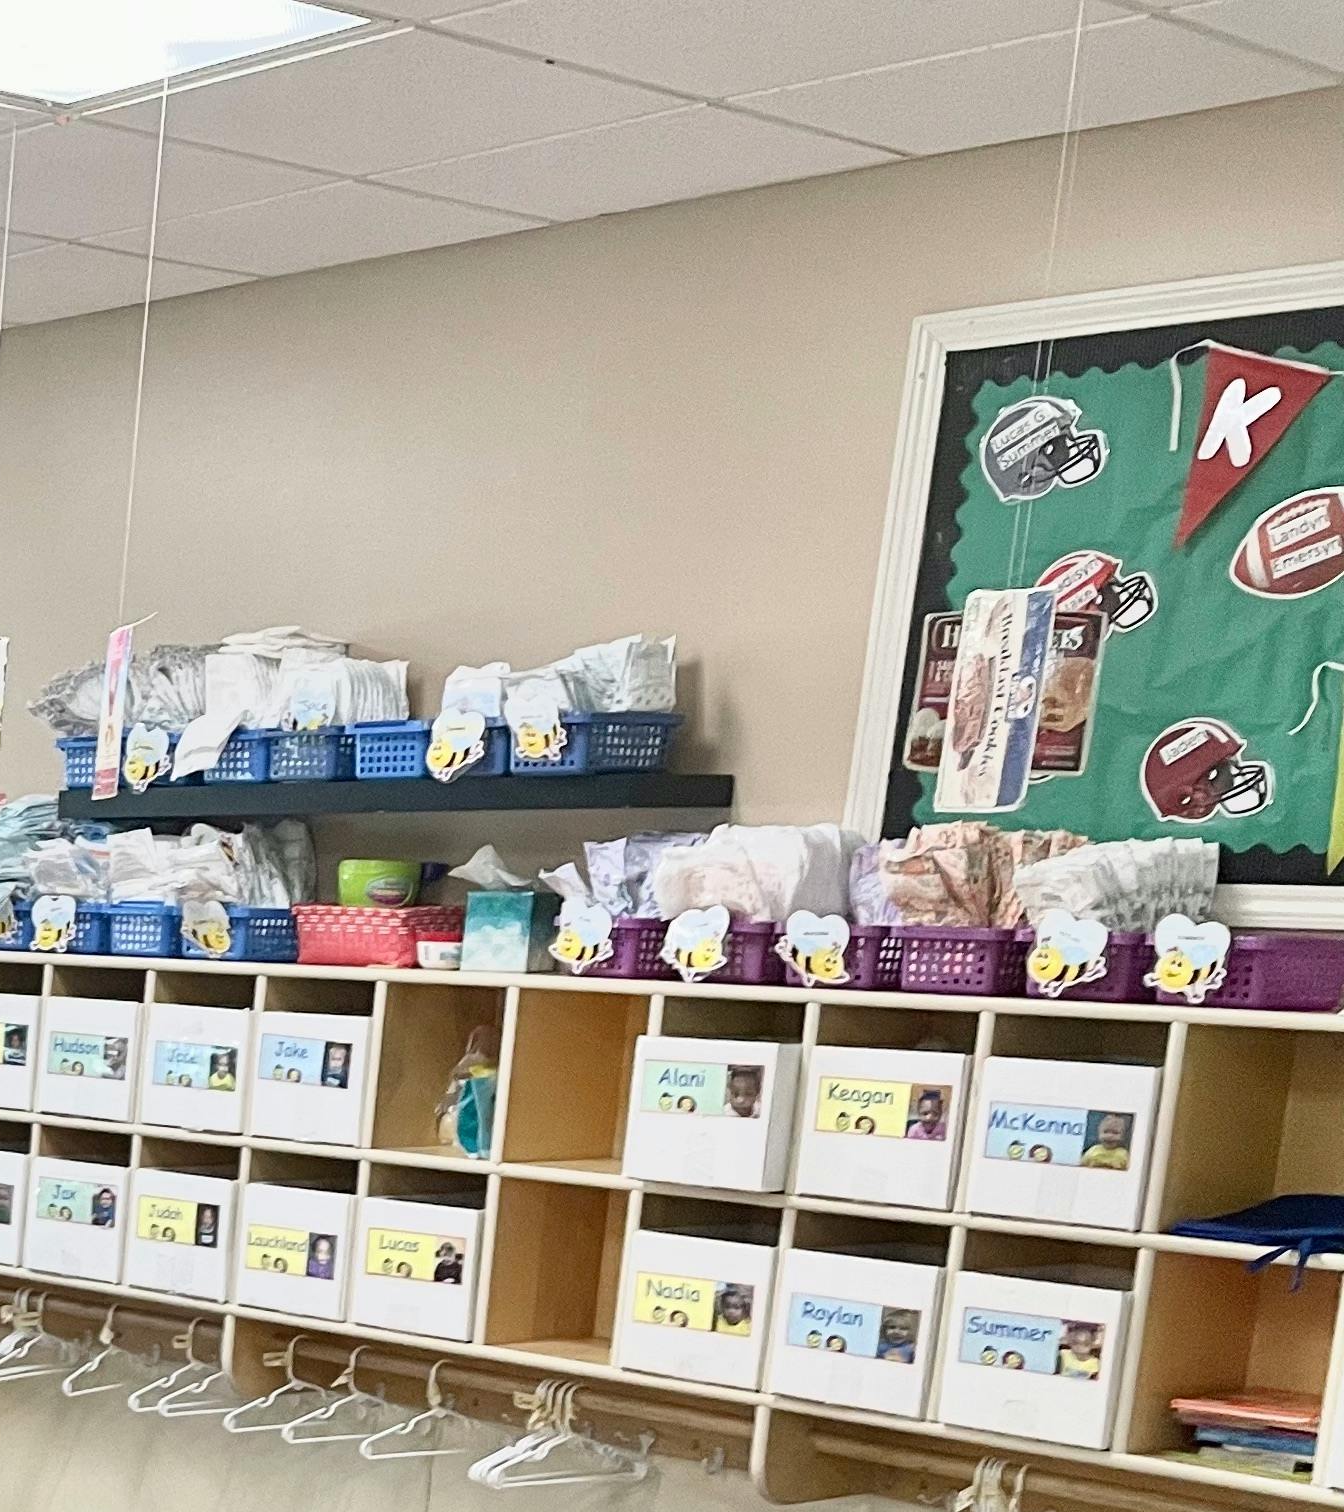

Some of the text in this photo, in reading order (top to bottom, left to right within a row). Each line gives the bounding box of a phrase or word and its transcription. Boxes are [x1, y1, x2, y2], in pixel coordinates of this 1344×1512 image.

[1197, 377, 1282, 468] K
[992, 423, 1030, 450] Lucas
[999, 424, 1059, 468] Summer
[1271, 514, 1328, 547] Landyn
[53, 1036, 100, 1056] Hudson
[274, 1040, 308, 1059] Jake
[658, 1068, 706, 1088] Alani
[827, 1082, 894, 1109] Keagan
[989, 1107, 1084, 1138] McKenna
[148, 1203, 183, 1220] Judah
[378, 1233, 419, 1252] Lucas
[646, 1278, 700, 1303] Nadia
[801, 1300, 864, 1329] Raylan
[967, 1314, 1051, 1344] Summer
